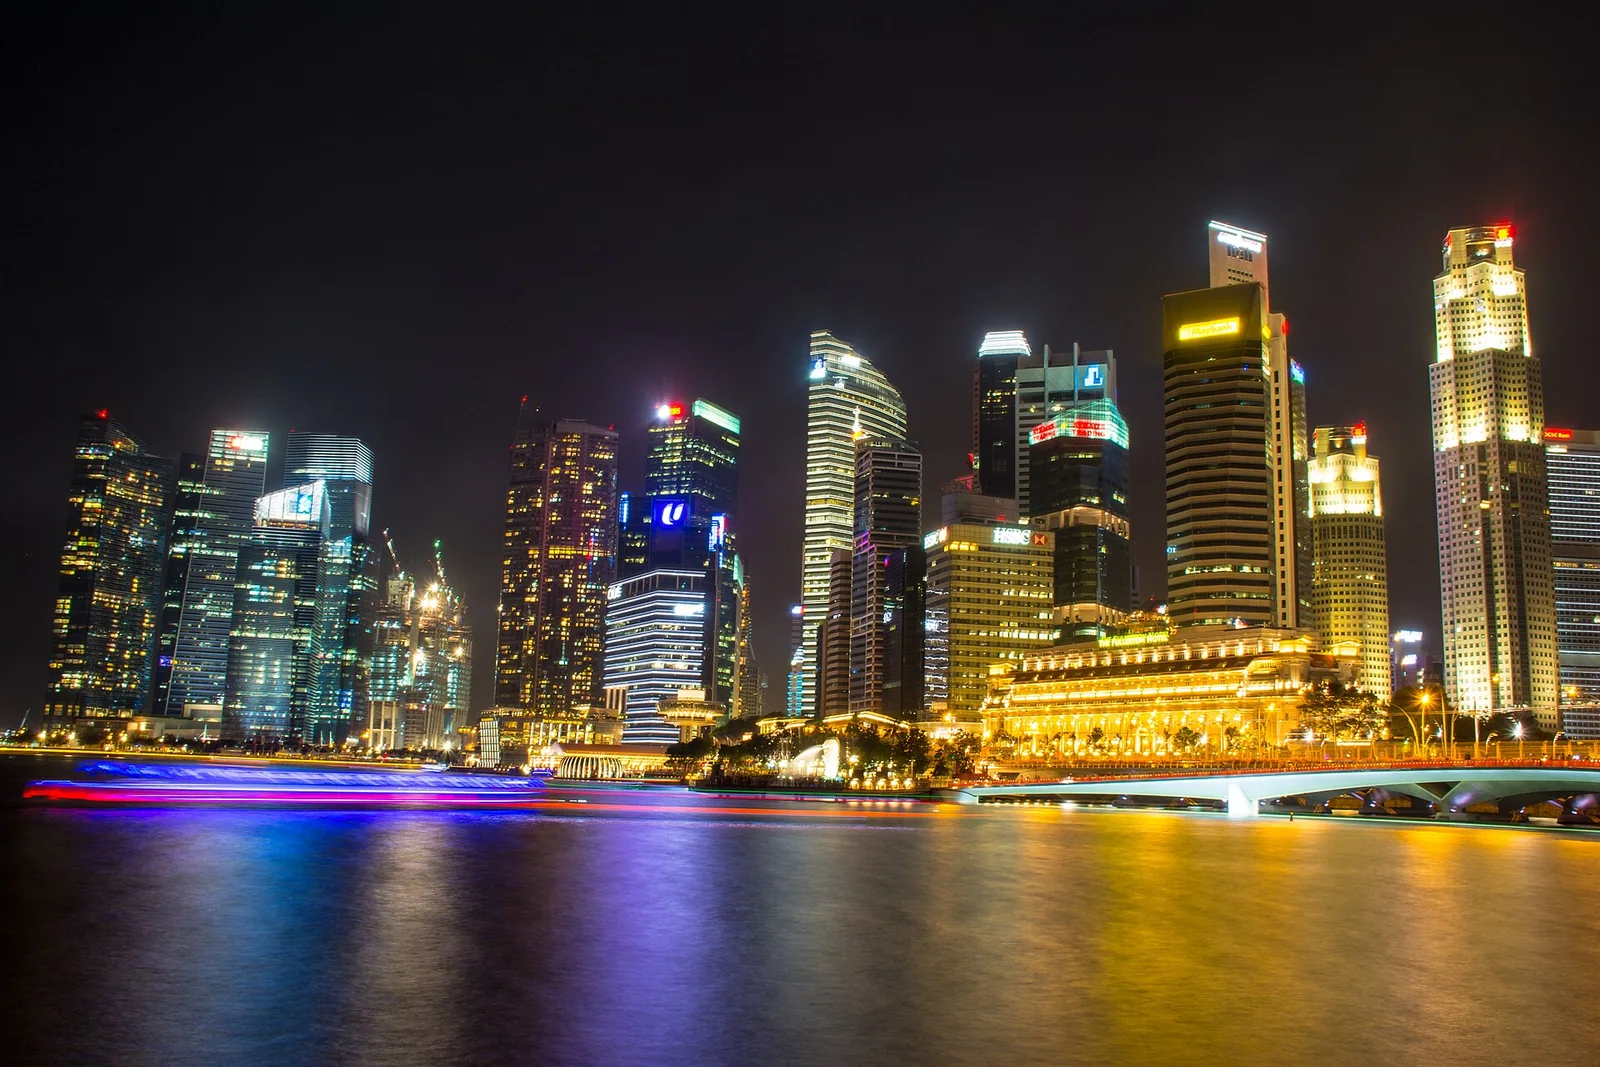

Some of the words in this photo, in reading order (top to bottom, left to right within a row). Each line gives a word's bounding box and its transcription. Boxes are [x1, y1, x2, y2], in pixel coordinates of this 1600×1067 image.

[1191, 322, 1233, 336] Maybank
[993, 527, 1031, 546] HSBC
[1146, 631, 1169, 644] HOTEL
